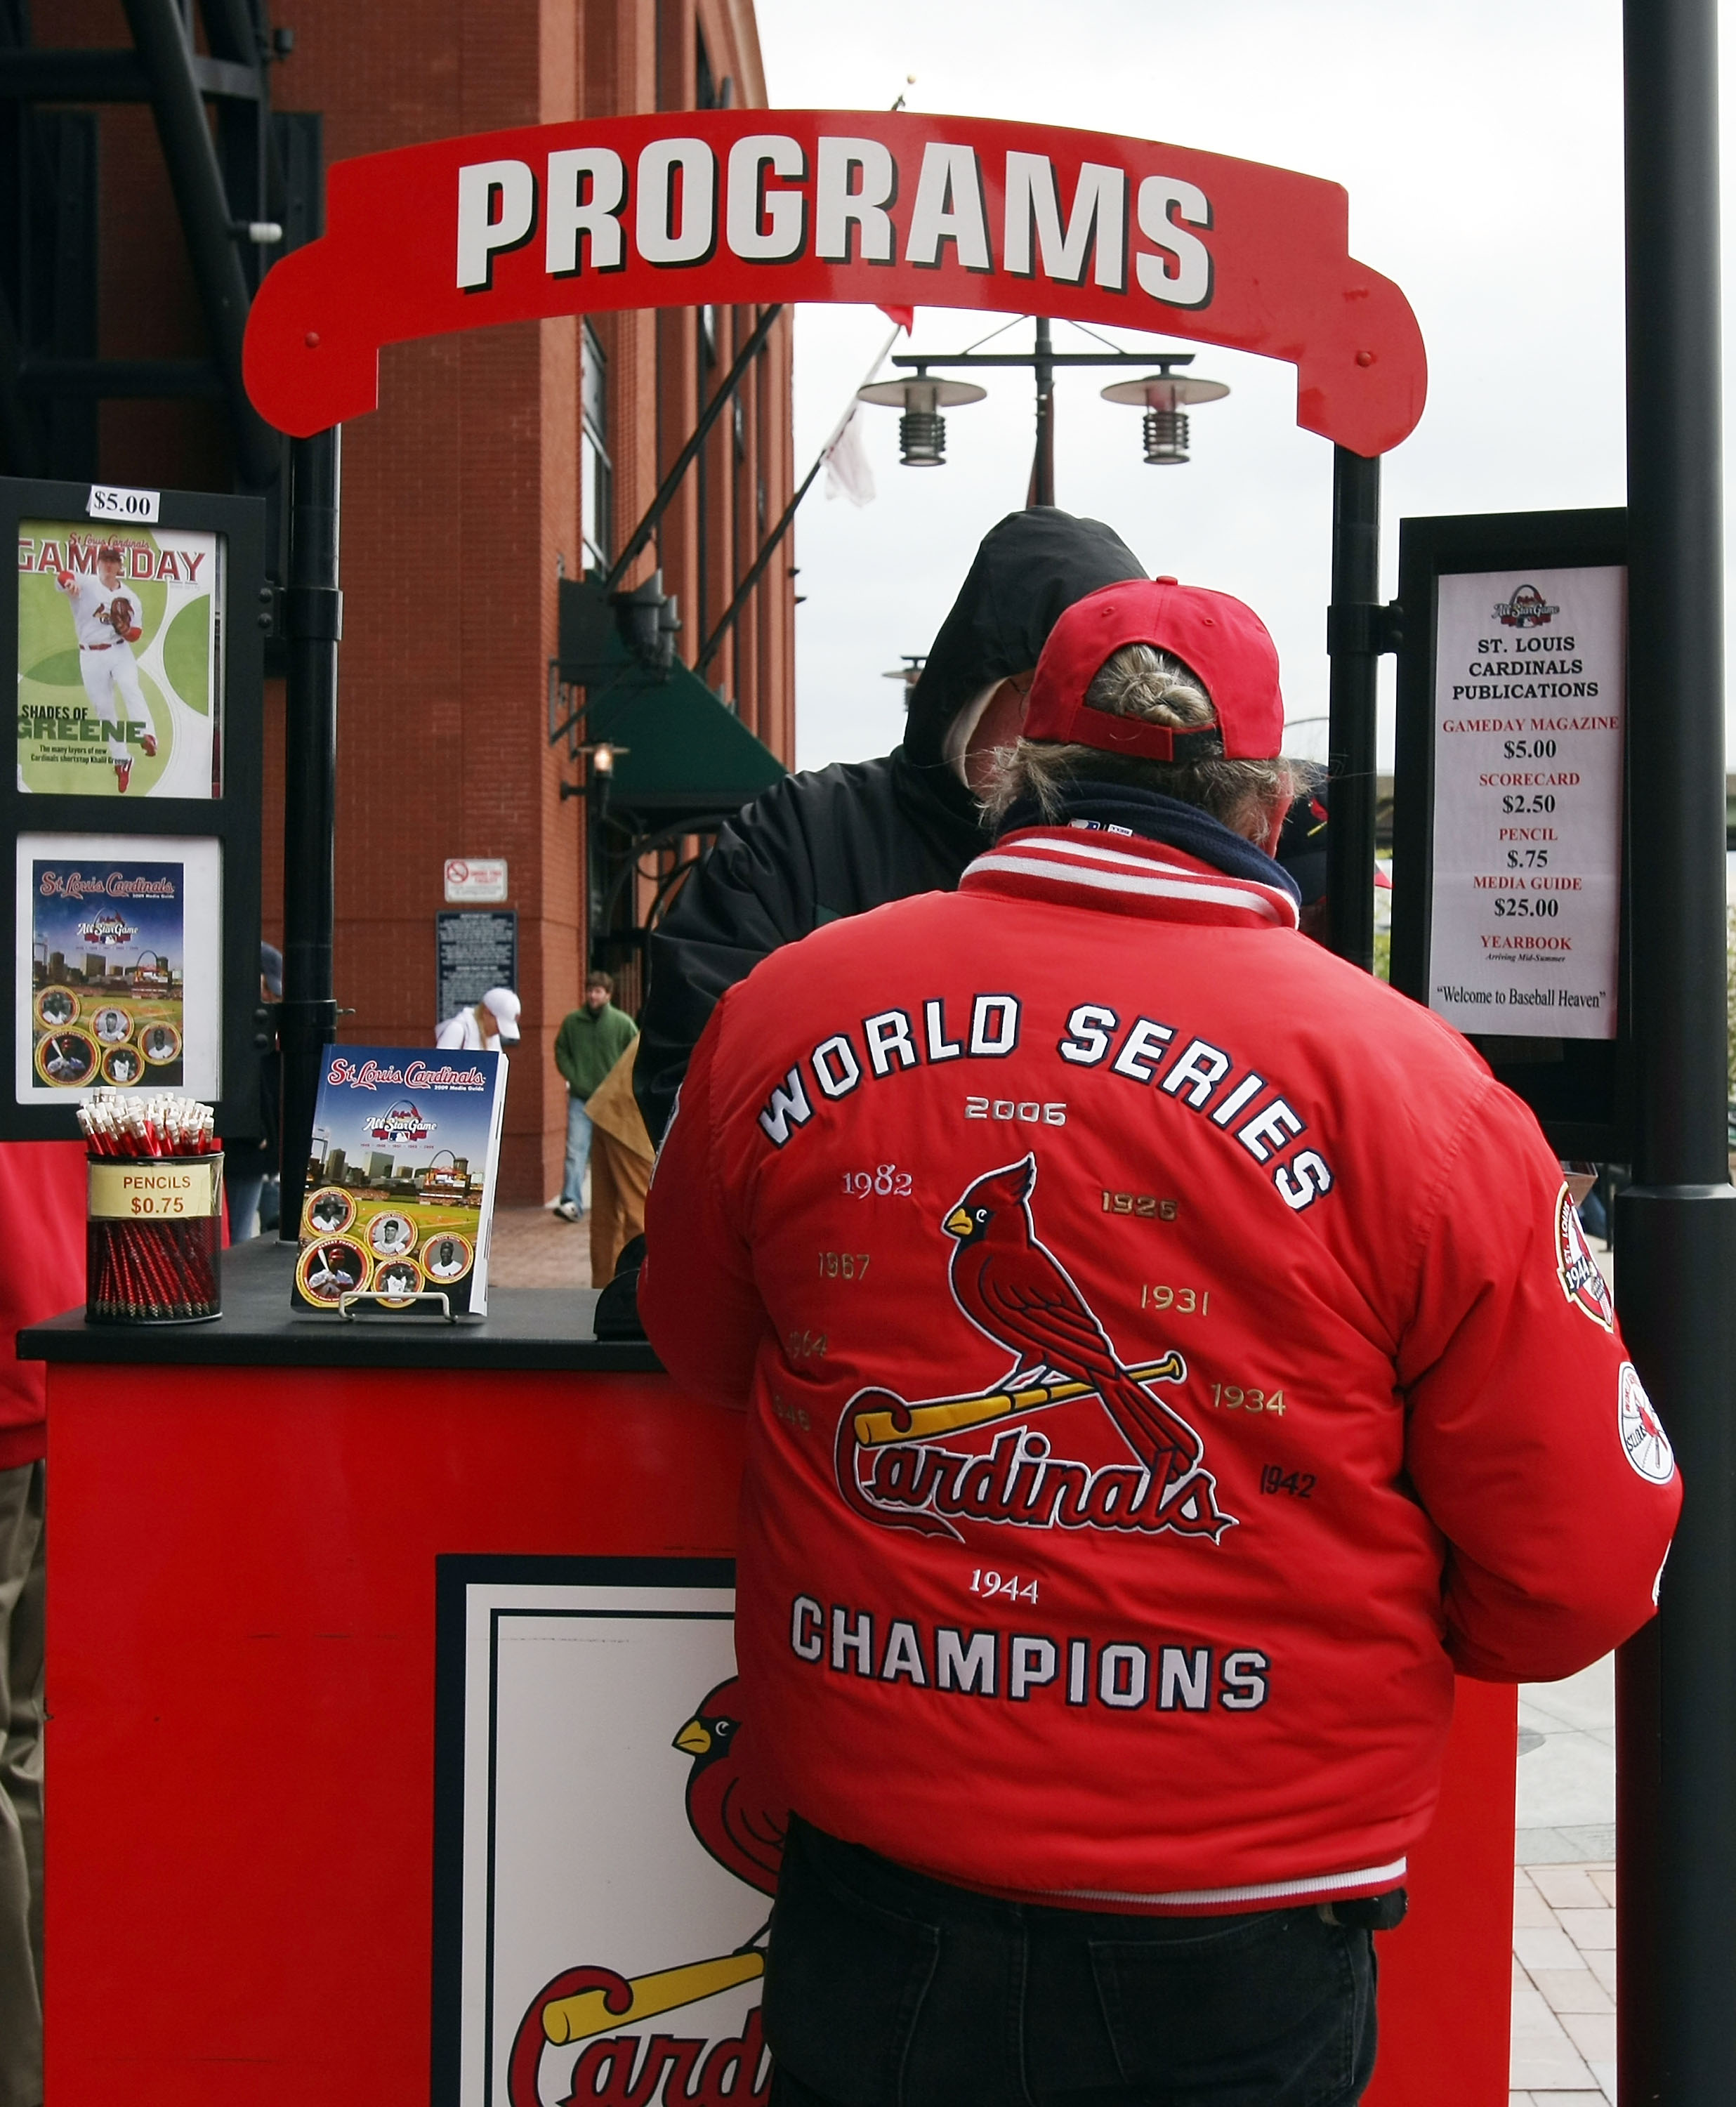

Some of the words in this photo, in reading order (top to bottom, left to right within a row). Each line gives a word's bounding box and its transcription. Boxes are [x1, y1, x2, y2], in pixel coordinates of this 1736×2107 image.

[456, 134, 1214, 310] PROGRAMS
[93, 490, 151, 516] $5.00
[84, 534, 105, 546] Louis
[107, 534, 150, 549] Cardinals
[1478, 639, 1507, 653] ST.
[1515, 636, 1575, 652] LOUIS
[1468, 659, 1583, 677] CARDINALS
[1452, 682, 1599, 700] PUBLICATIONS
[22, 704, 70, 719] SHADES
[73, 707, 88, 721] OF
[18, 718, 146, 743] GREENE
[1442, 718, 1525, 733] GAMEDAY
[1530, 716, 1619, 731] MAGAZINE
[40, 744, 50, 753] The
[69, 746, 86, 755] layers
[1504, 740, 1557, 759] $5.00
[31, 754, 58, 763] Cardinals
[60, 755, 89, 765] shortstop
[91, 756, 107, 764] Khalil
[1479, 773, 1580, 786] SCORECARD
[1502, 794, 1556, 814] $2.50
[1499, 827, 1558, 841] PENCIL
[1507, 850, 1548, 868] $.75
[60, 872, 105, 900] Louis
[106, 872, 174, 898] Cardinals
[1473, 876, 1525, 889] MEDIA
[1530, 877, 1582, 890] GUIDE
[1494, 898, 1559, 917] $25.00
[114, 923, 139, 936] Game
[1480, 936, 1572, 950] YEARBOOK
[1485, 953, 1516, 962] Arriving
[1518, 953, 1566, 963] Mid-Summer
[1495, 990, 1506, 1004] to
[1509, 987, 1554, 1006] Baseball
[351, 1060, 403, 1091] Louis
[404, 1061, 485, 1089] Cardinals
[758, 992, 1022, 1149] WORLD
[1058, 1002, 1334, 1212] SERIES
[965, 1096, 1067, 1127] 2006
[362, 1117, 385, 1131] All
[384, 1117, 408, 1131] Star
[408, 1119, 437, 1134] Game
[124, 1176, 190, 1189] PENCILS
[843, 1164, 912, 1199] 1982
[131, 1197, 184, 1215] $0.75
[819, 1252, 871, 1281] 1967
[1566, 1255, 1590, 1289] 1944
[1141, 1285, 1209, 1316] 1931
[1211, 1382, 1287, 1416] 1934
[835, 1386, 1239, 1545] Cardinals
[1261, 1464, 1317, 1497] 1942
[969, 1569, 1039, 1605] 1944
[789, 1591, 1270, 1712] CHAMPIONS
[507, 1965, 775, 2107] Card
